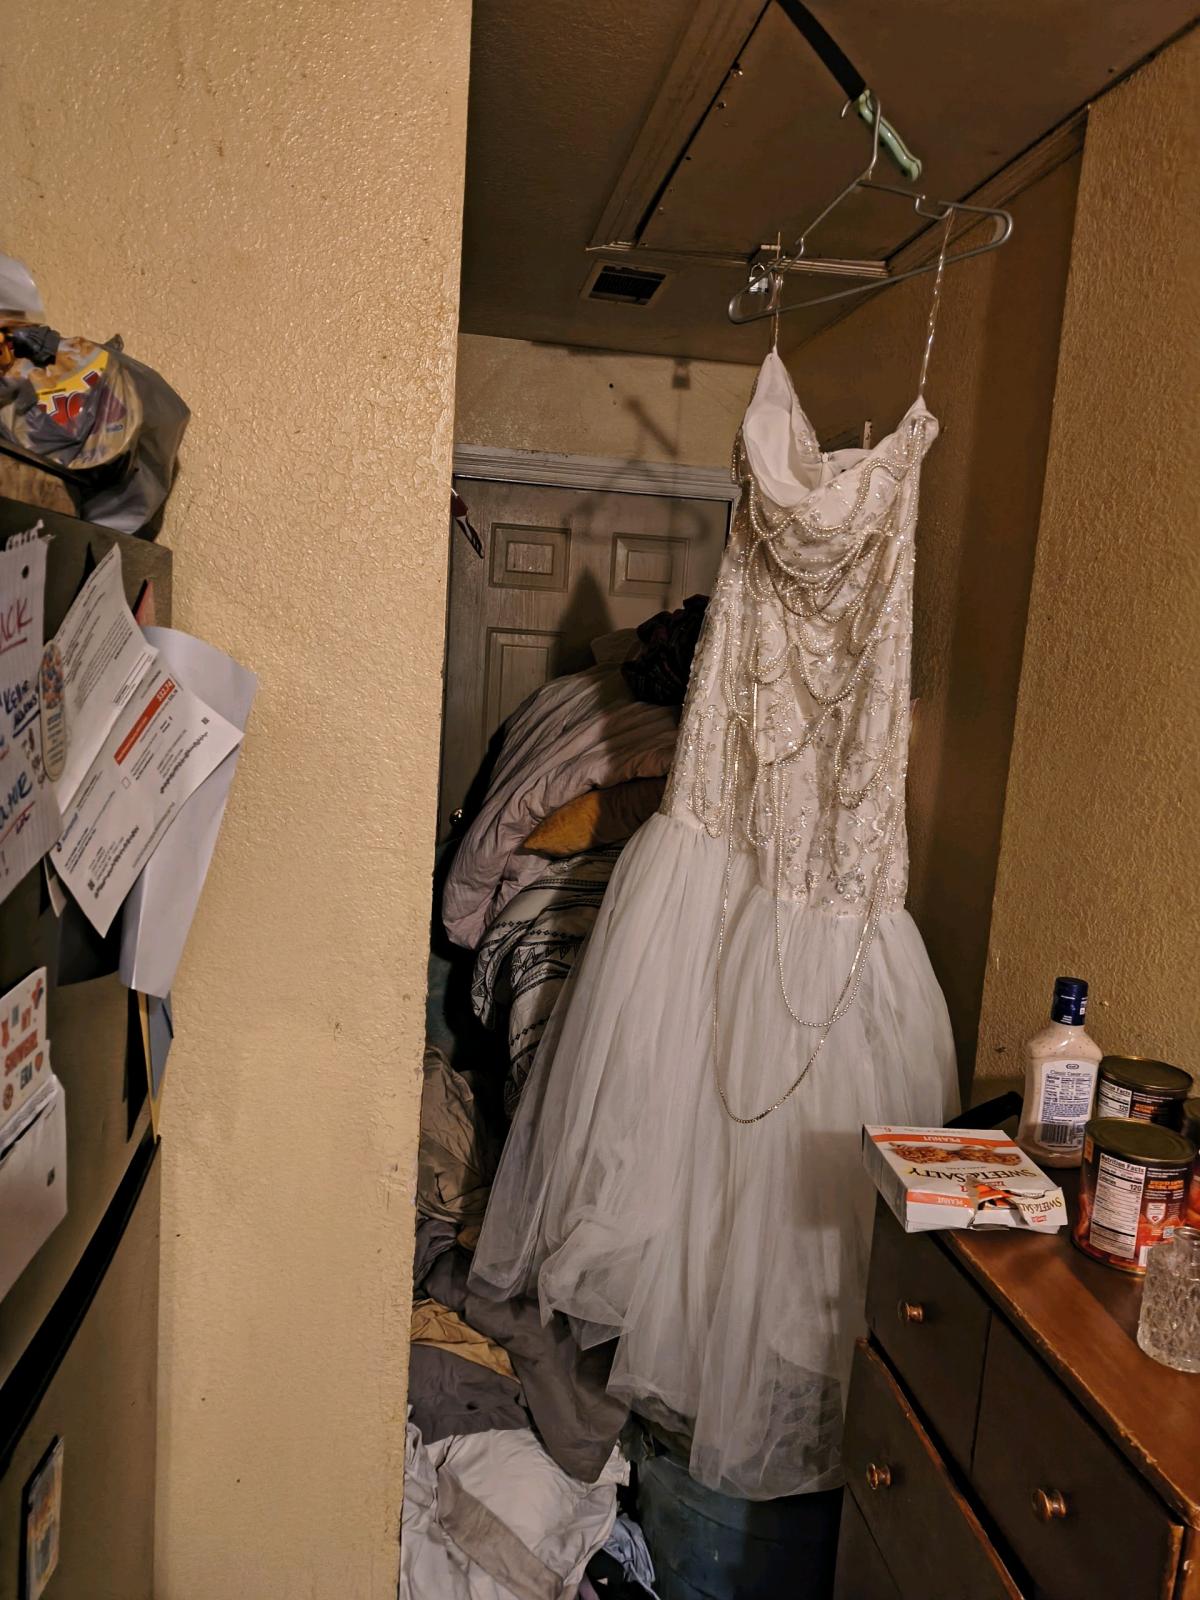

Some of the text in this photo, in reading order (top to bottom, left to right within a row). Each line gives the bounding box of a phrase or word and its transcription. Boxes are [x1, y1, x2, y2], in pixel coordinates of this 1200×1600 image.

[922, 1135, 961, 1143] PEANUT
[1126, 1163, 1145, 1173] Facts
[1129, 1184, 1142, 1192] 120
[937, 1197, 964, 1206] PEANUT
